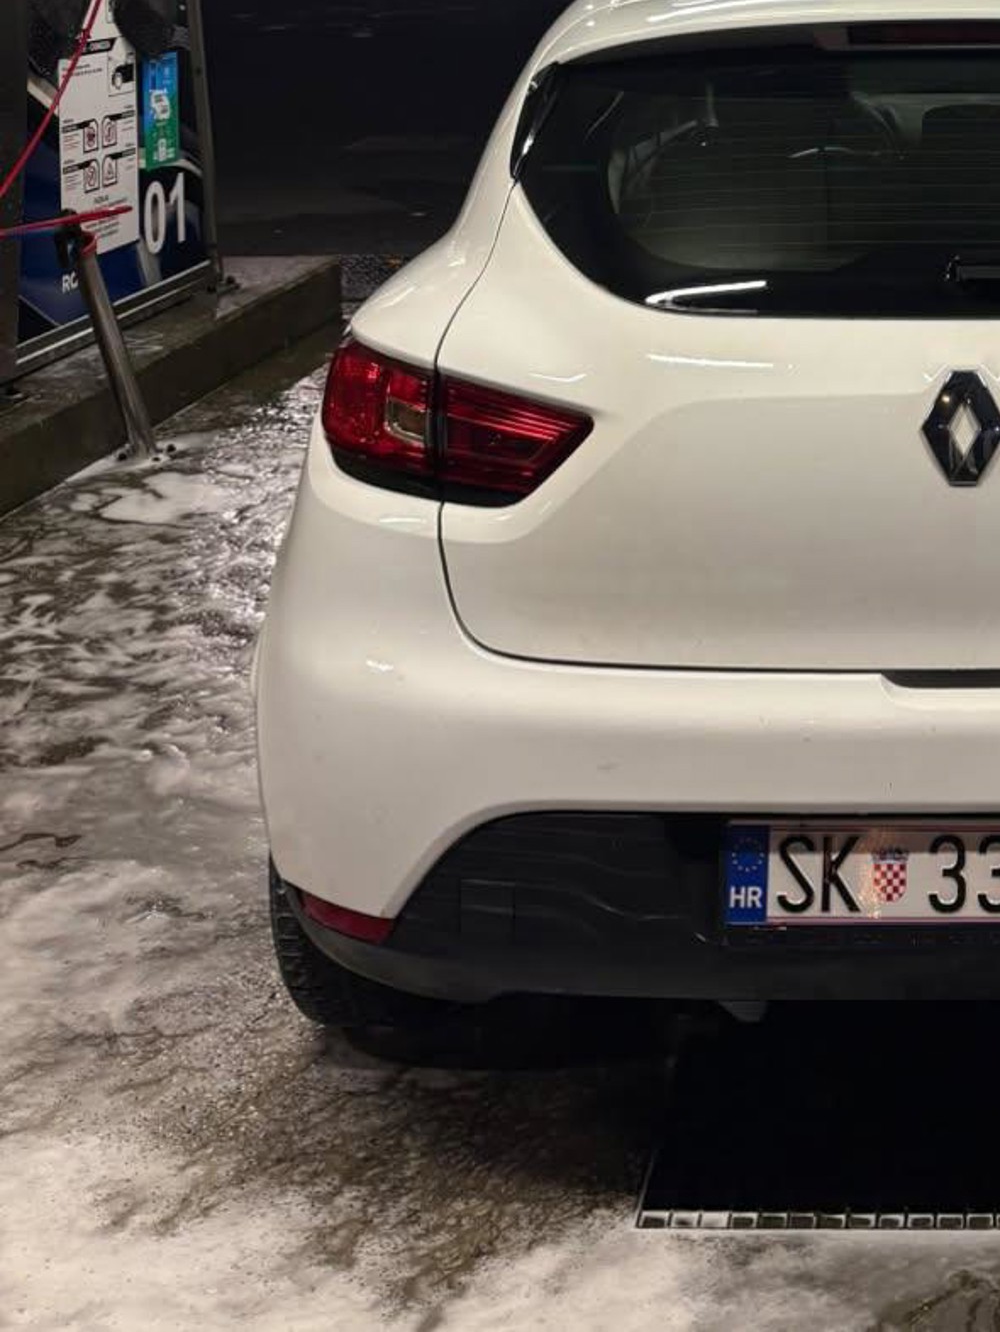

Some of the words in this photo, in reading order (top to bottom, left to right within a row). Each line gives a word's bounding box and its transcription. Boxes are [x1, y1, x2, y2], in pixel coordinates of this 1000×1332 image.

[144, 171, 187, 254] 01
[729, 885, 763, 909] HR
[776, 834, 863, 914] SK
